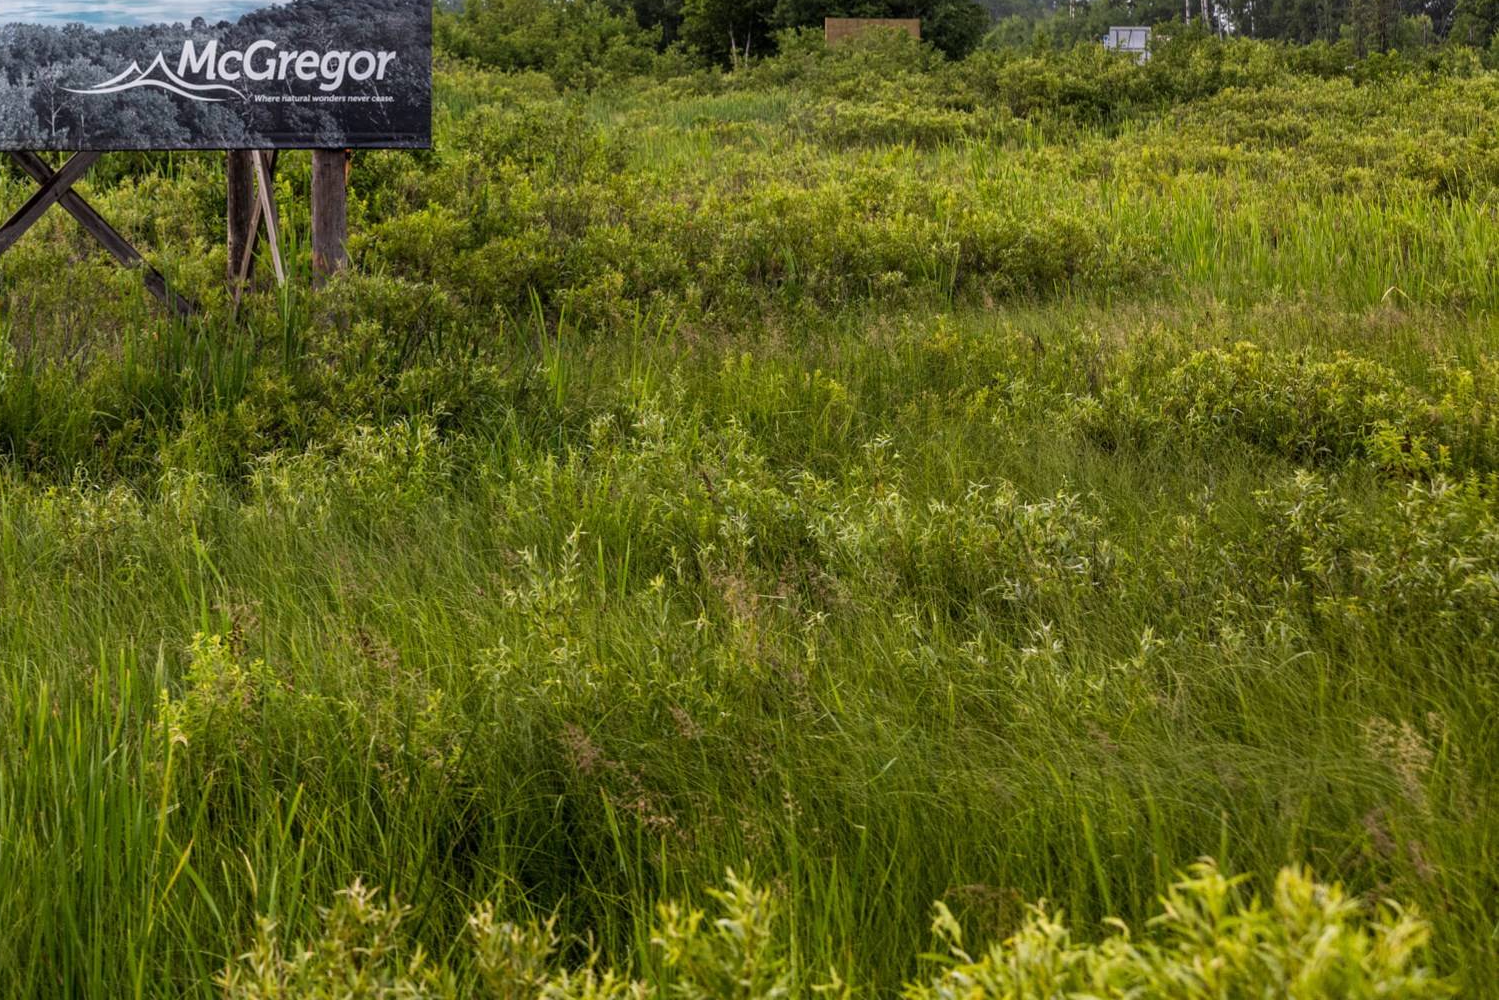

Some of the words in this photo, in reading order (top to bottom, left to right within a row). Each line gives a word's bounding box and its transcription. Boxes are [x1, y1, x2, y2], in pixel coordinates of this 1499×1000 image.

[176, 39, 397, 92] McGregor
[254, 94, 280, 103] Where
[281, 94, 311, 103] natural
[311, 94, 346, 103] wonders
[347, 95, 371, 103] never
[371, 95, 395, 103] cease.
